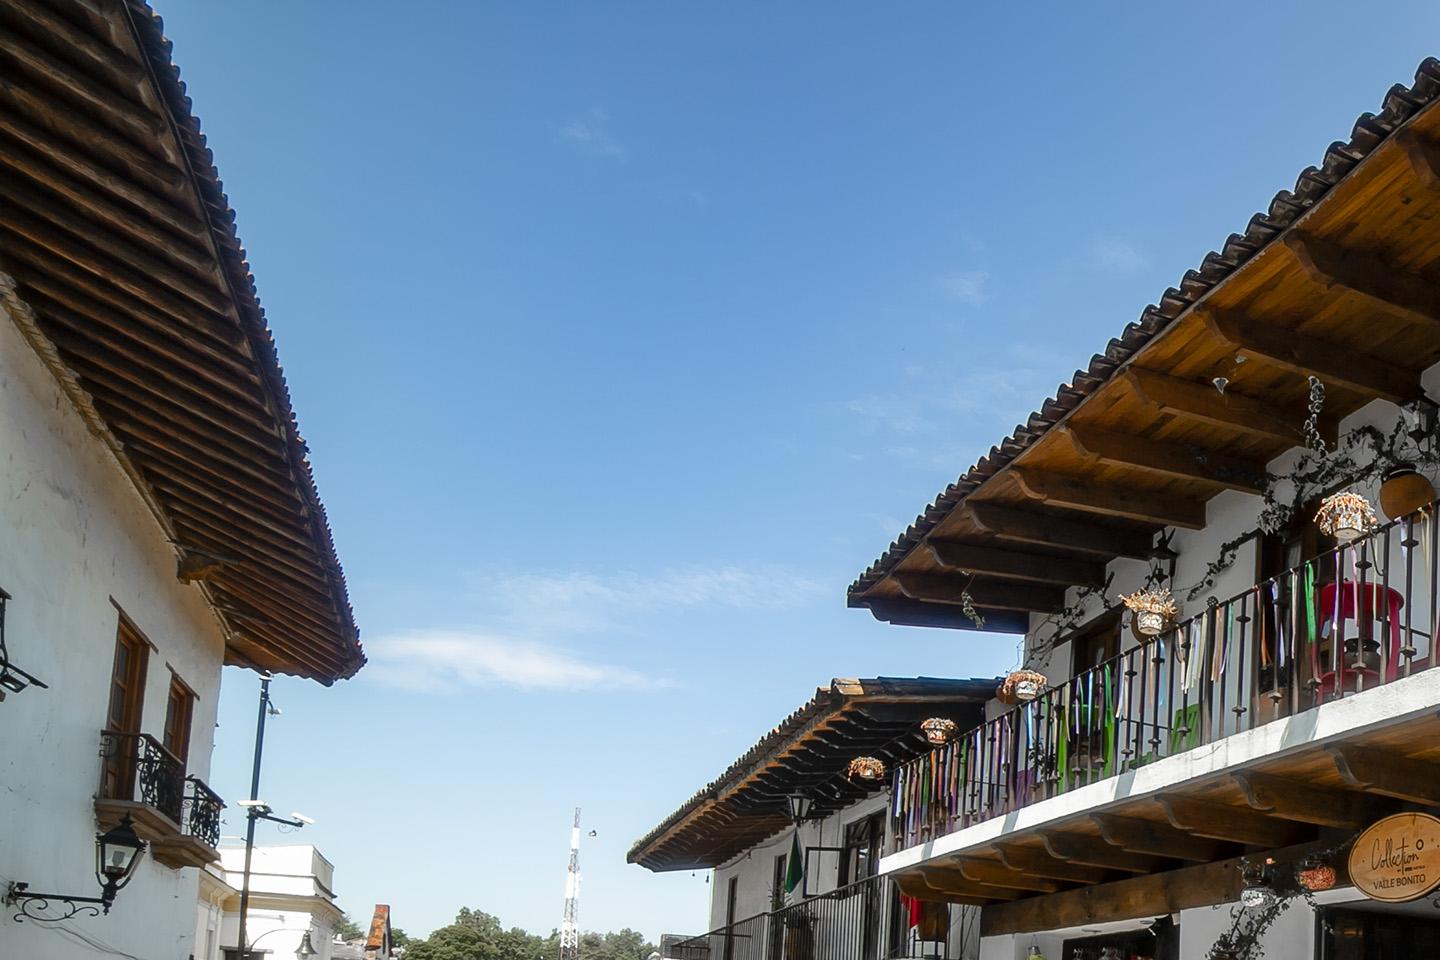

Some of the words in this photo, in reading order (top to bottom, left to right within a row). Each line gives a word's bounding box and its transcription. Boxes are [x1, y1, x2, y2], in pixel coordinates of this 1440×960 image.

[1371, 837, 1420, 876] Collection
[1373, 878, 1395, 890] VALLE
[1396, 873, 1426, 887] BONITO
